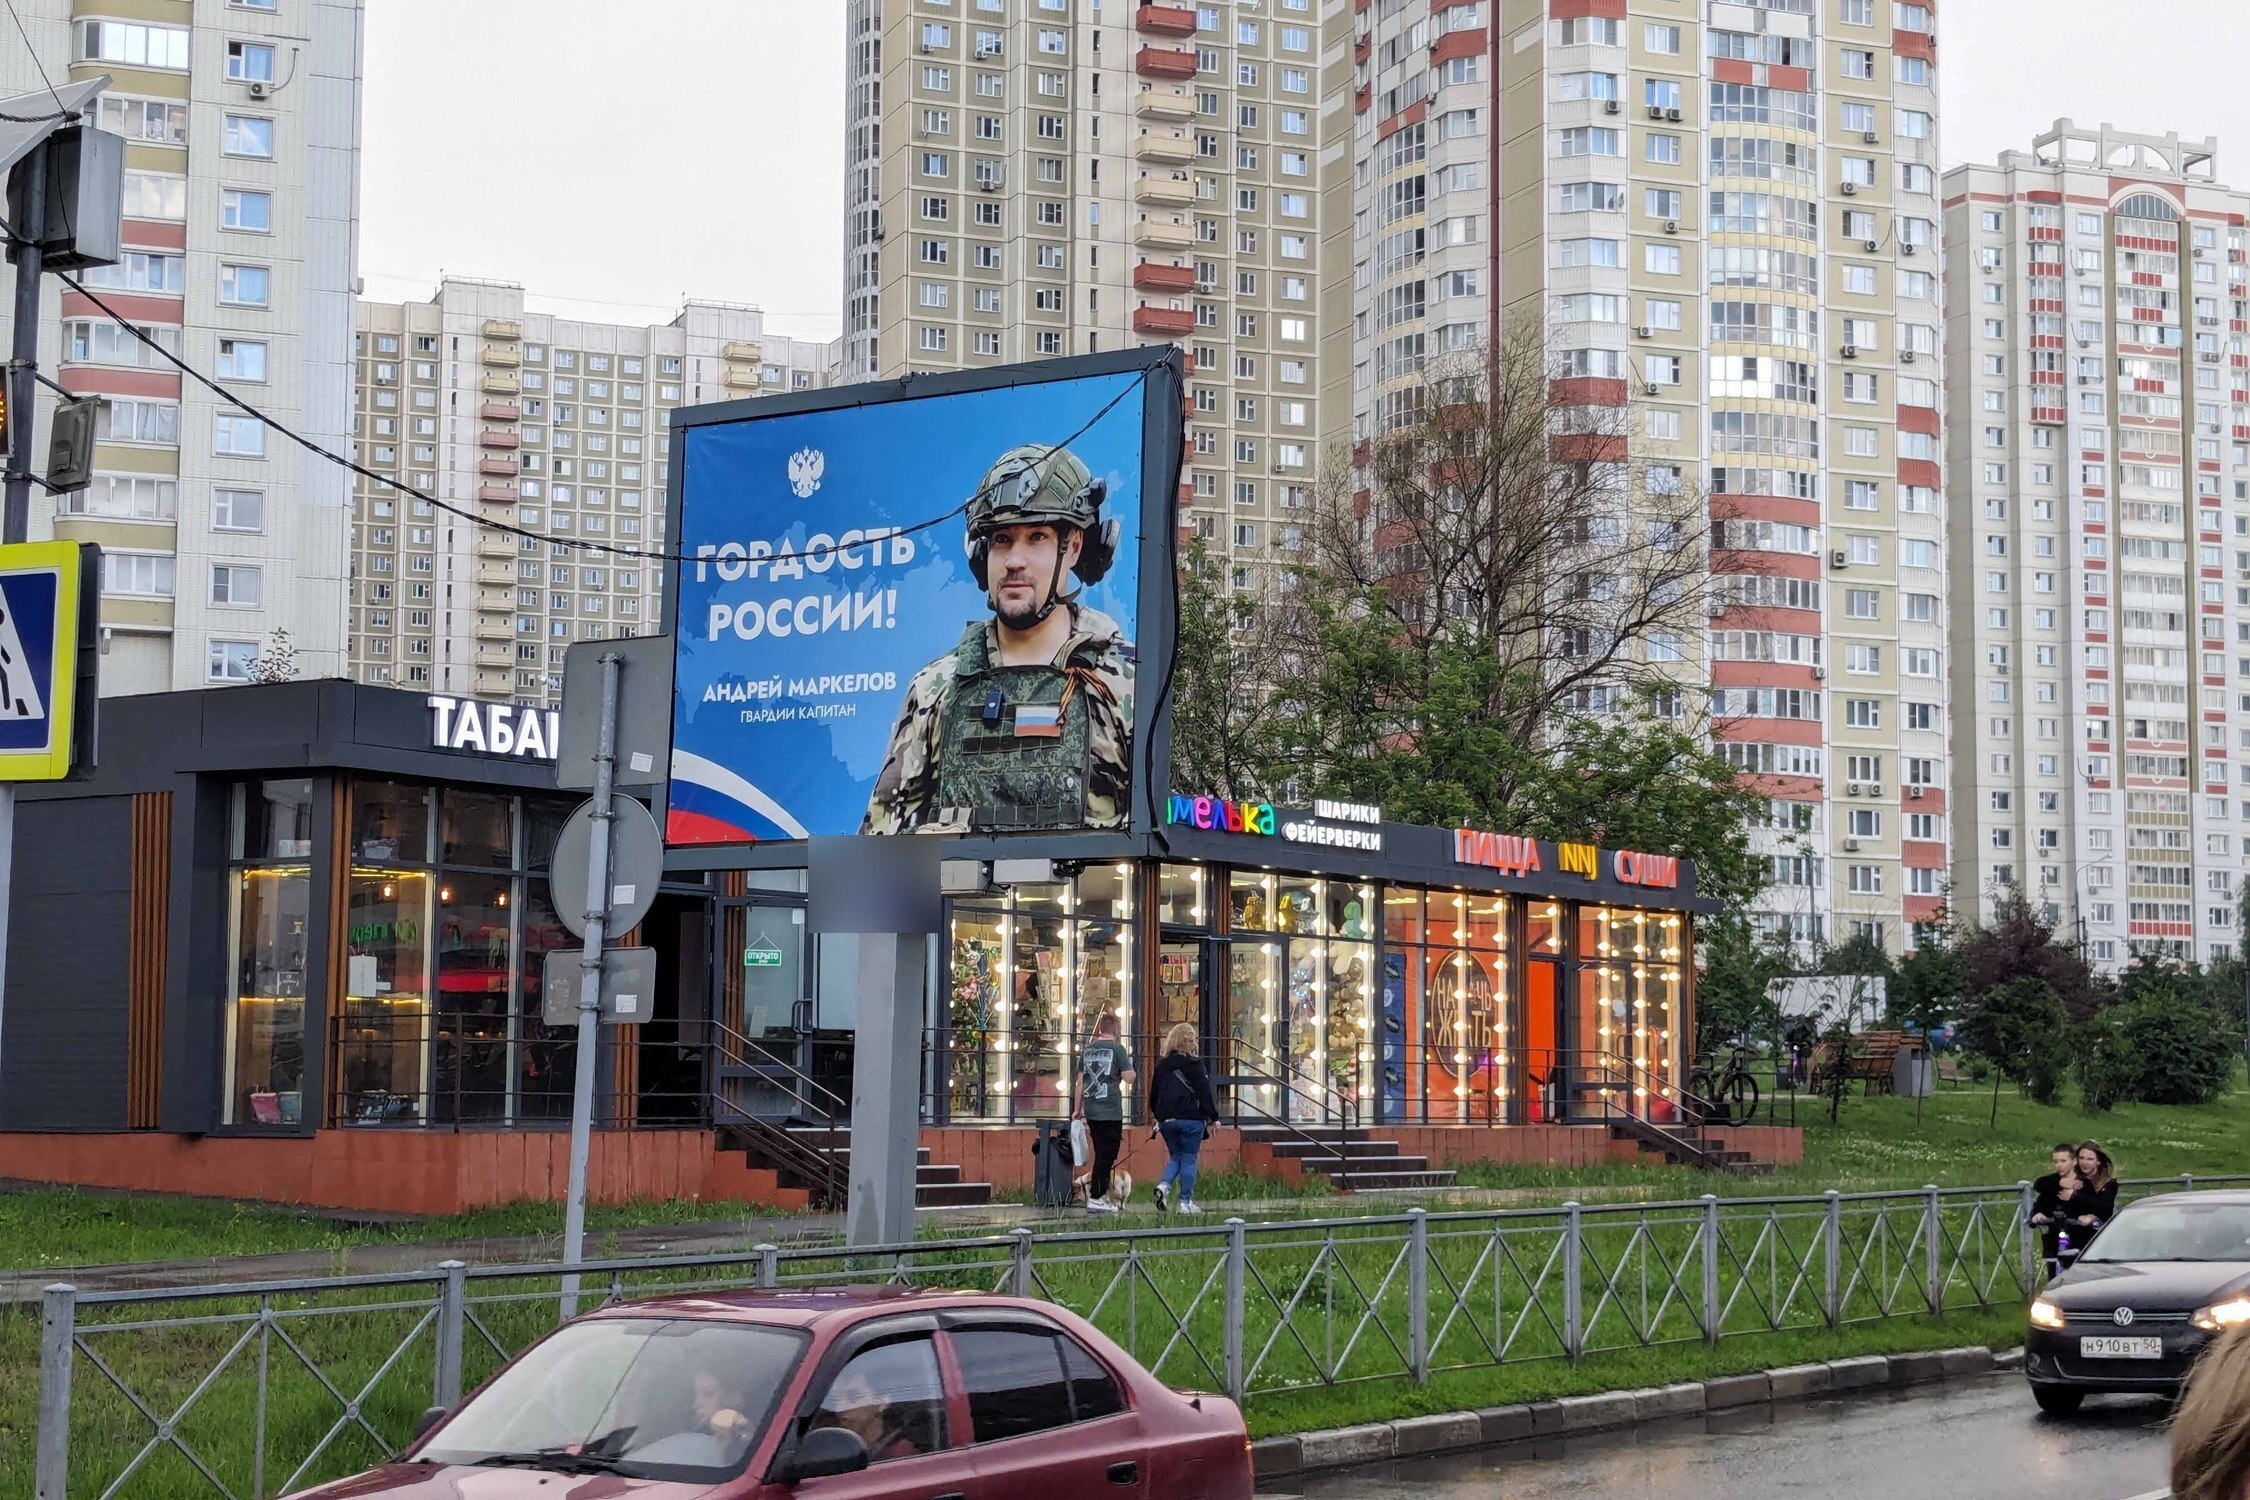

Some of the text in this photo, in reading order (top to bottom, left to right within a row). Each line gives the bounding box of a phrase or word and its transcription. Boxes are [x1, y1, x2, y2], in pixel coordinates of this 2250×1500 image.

[696, 526, 915, 583] ГОРДОСТЬ
[708, 589, 898, 642] РОССИИ!
[702, 671, 897, 704] АНДРЕЙ МАРКЕЛОВ
[740, 703, 857, 724] ГВАРДИИ КАПИТАН
[1315, 799, 1380, 824] ШАРИКИ
[1281, 819, 1381, 851] ФЕЙЕРВЕРКИ
[1454, 828, 1541, 878] ПИЦЦА
[1613, 850, 1678, 888] СУШИ
[747, 952, 779, 960] ОТКРЫТО
